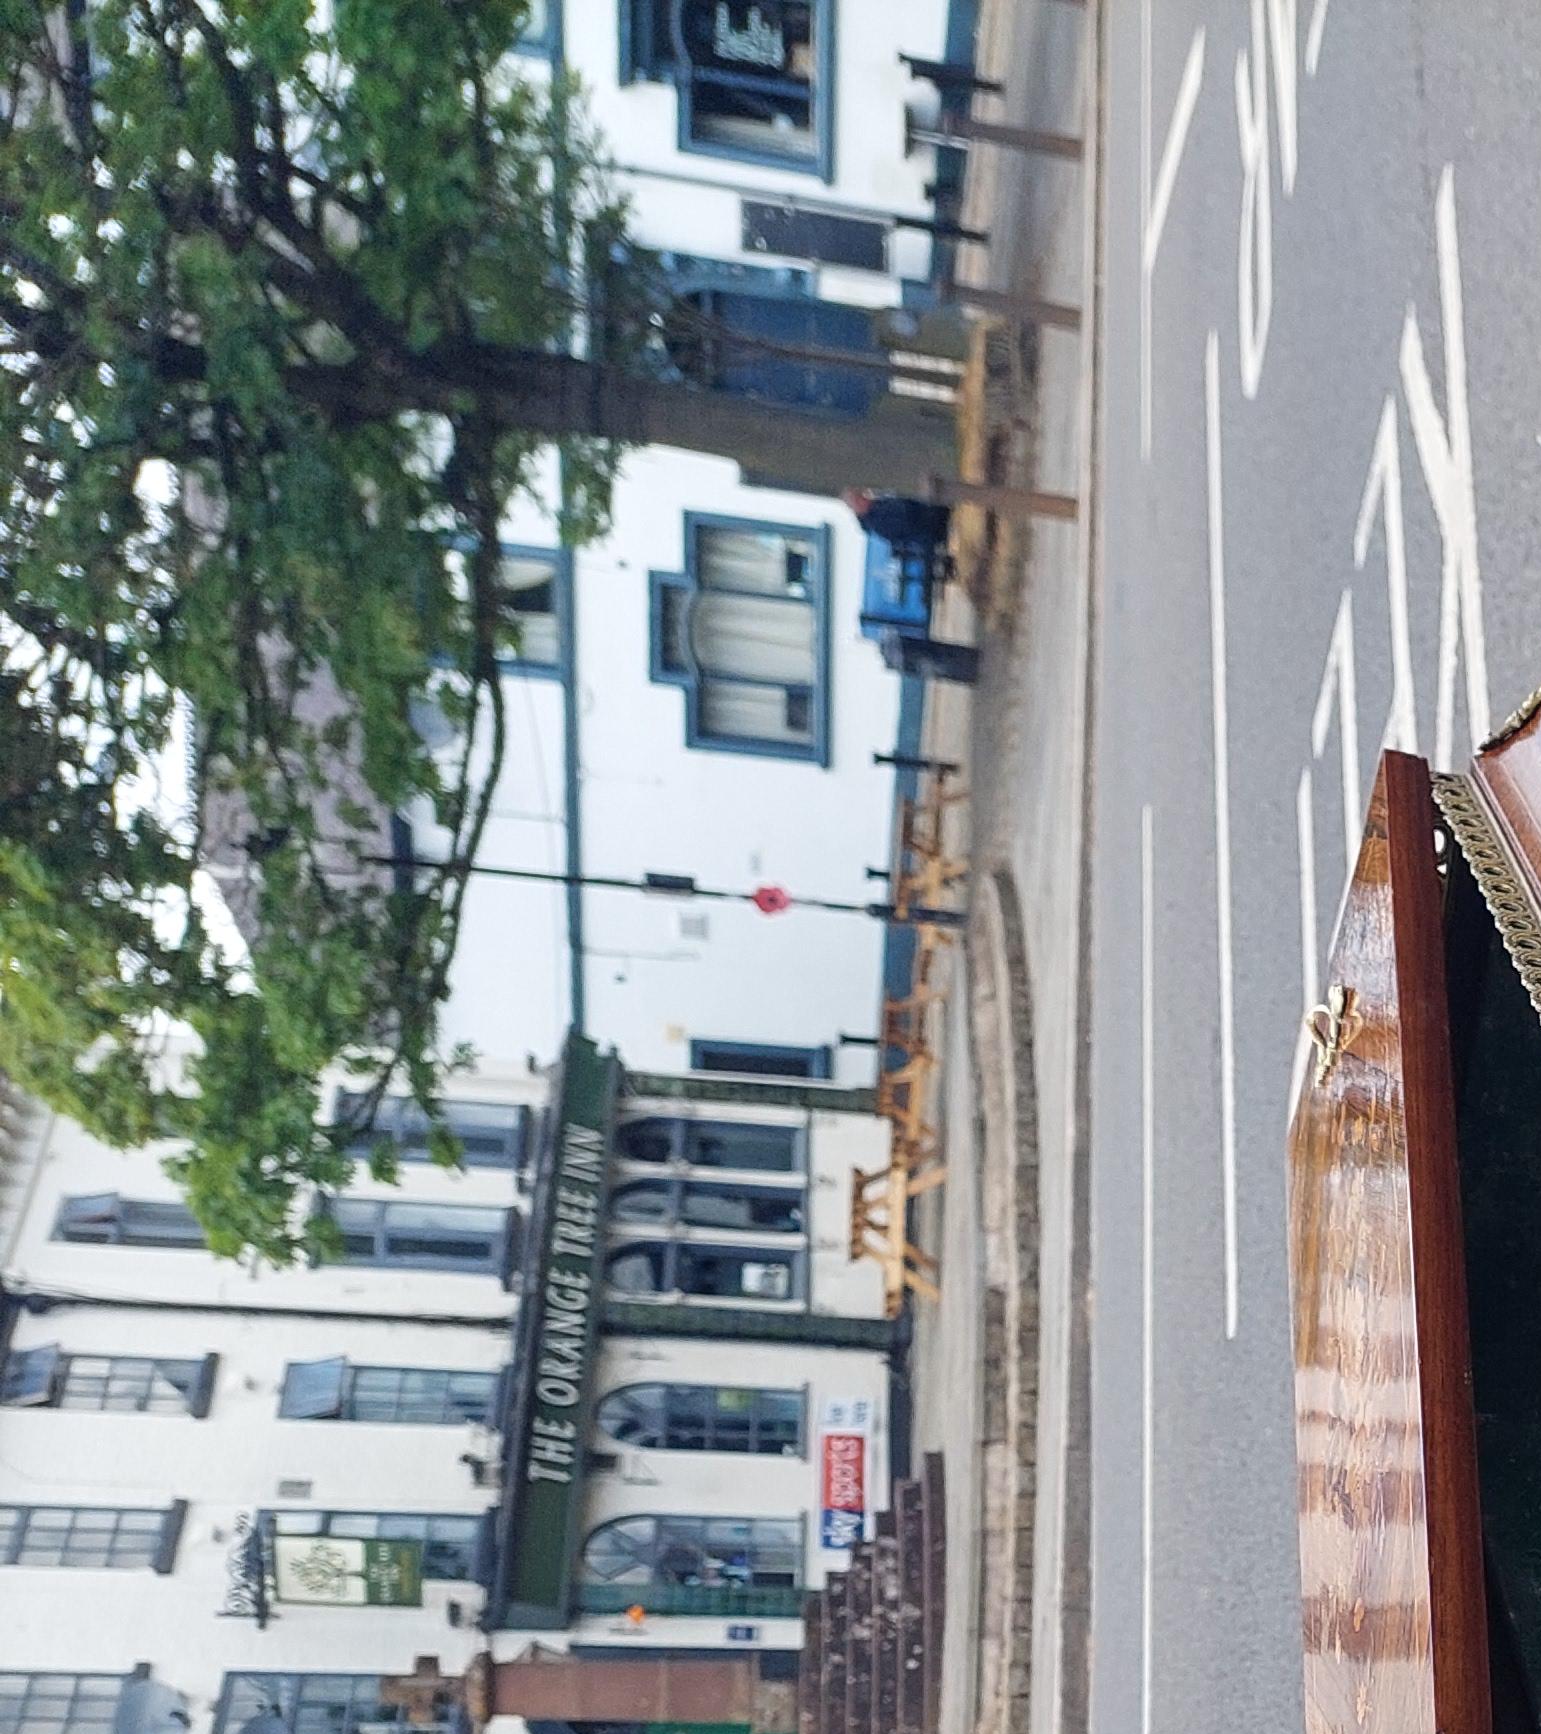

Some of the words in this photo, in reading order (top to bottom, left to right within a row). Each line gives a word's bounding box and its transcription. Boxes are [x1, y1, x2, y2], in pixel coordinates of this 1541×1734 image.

[559, 1122, 605, 1184] INN
[550, 1185, 599, 1257] TREE
[535, 1267, 591, 1407] ORANGE
[527, 1416, 577, 1483] THE
